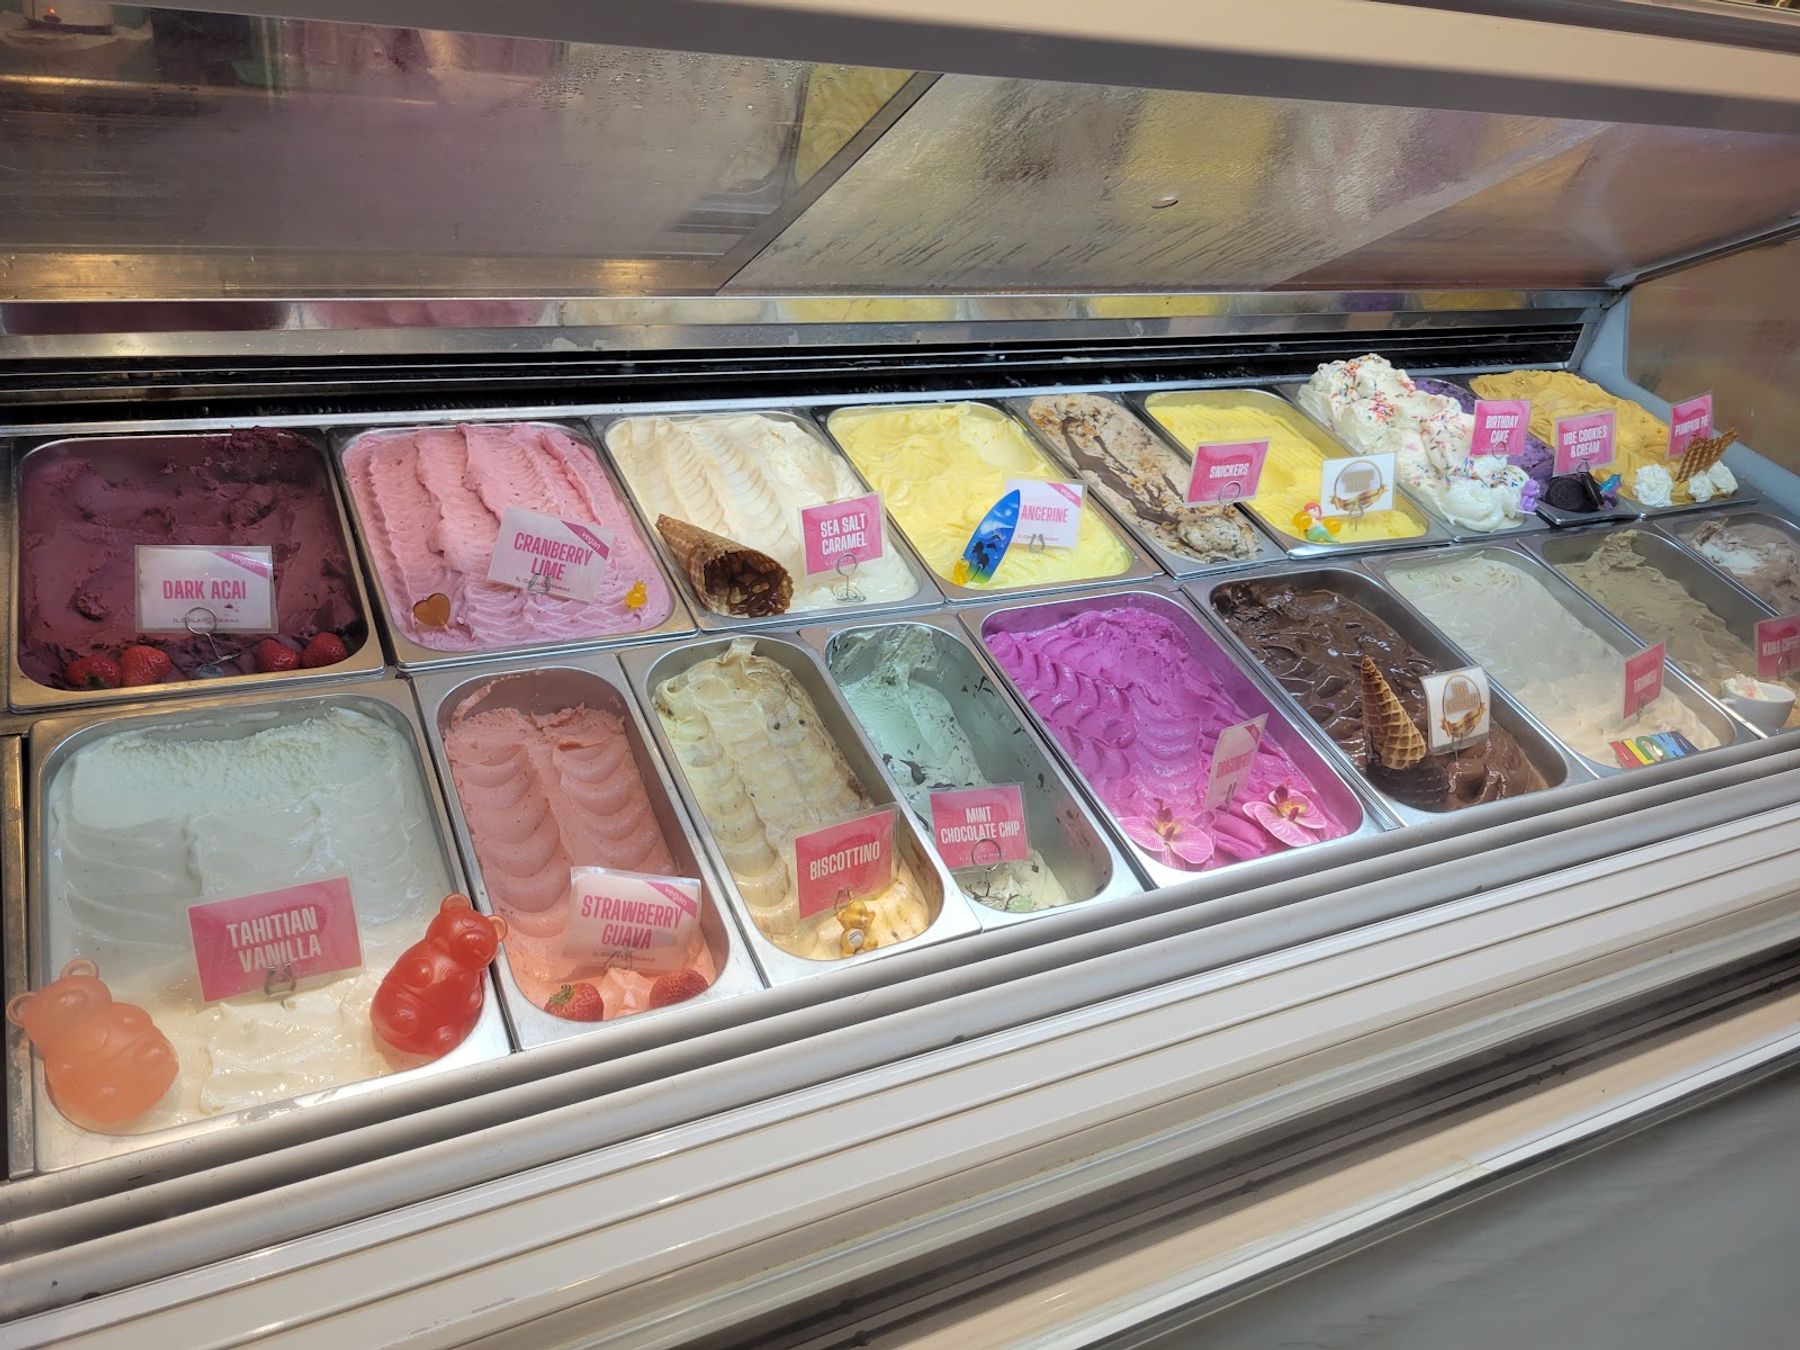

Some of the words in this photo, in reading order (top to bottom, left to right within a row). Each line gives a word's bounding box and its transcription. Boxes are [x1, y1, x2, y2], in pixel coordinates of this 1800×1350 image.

[1485, 415, 1519, 429] BIRTHDAY
[1490, 430, 1510, 443] CAKE
[1563, 431, 1578, 445] UBE
[1578, 425, 1608, 442] COOKIES
[1209, 463, 1250, 478] SNICKERS
[820, 519, 840, 538] SEA
[842, 513, 866, 533] SALT
[1020, 505, 1068, 523] ANGERINE
[513, 532, 593, 566] CRANBERRY
[581, 531, 601, 550] vegan
[821, 531, 867, 556] CARAMEL
[531, 557, 566, 581] LIME
[162, 580, 205, 599] DARK
[211, 579, 247, 600] ACAI
[965, 806, 991, 823] MINT
[940, 823, 997, 844] CHOCOLATE
[998, 820, 1020, 837] CHIP
[809, 841, 880, 881] BISCOTTINO
[664, 886, 688, 907] vegan
[581, 894, 683, 929] STRAWBERRY
[226, 906, 319, 949] TAHITIAN
[601, 923, 653, 950] GUAVA
[238, 934, 323, 973] VANILLA
